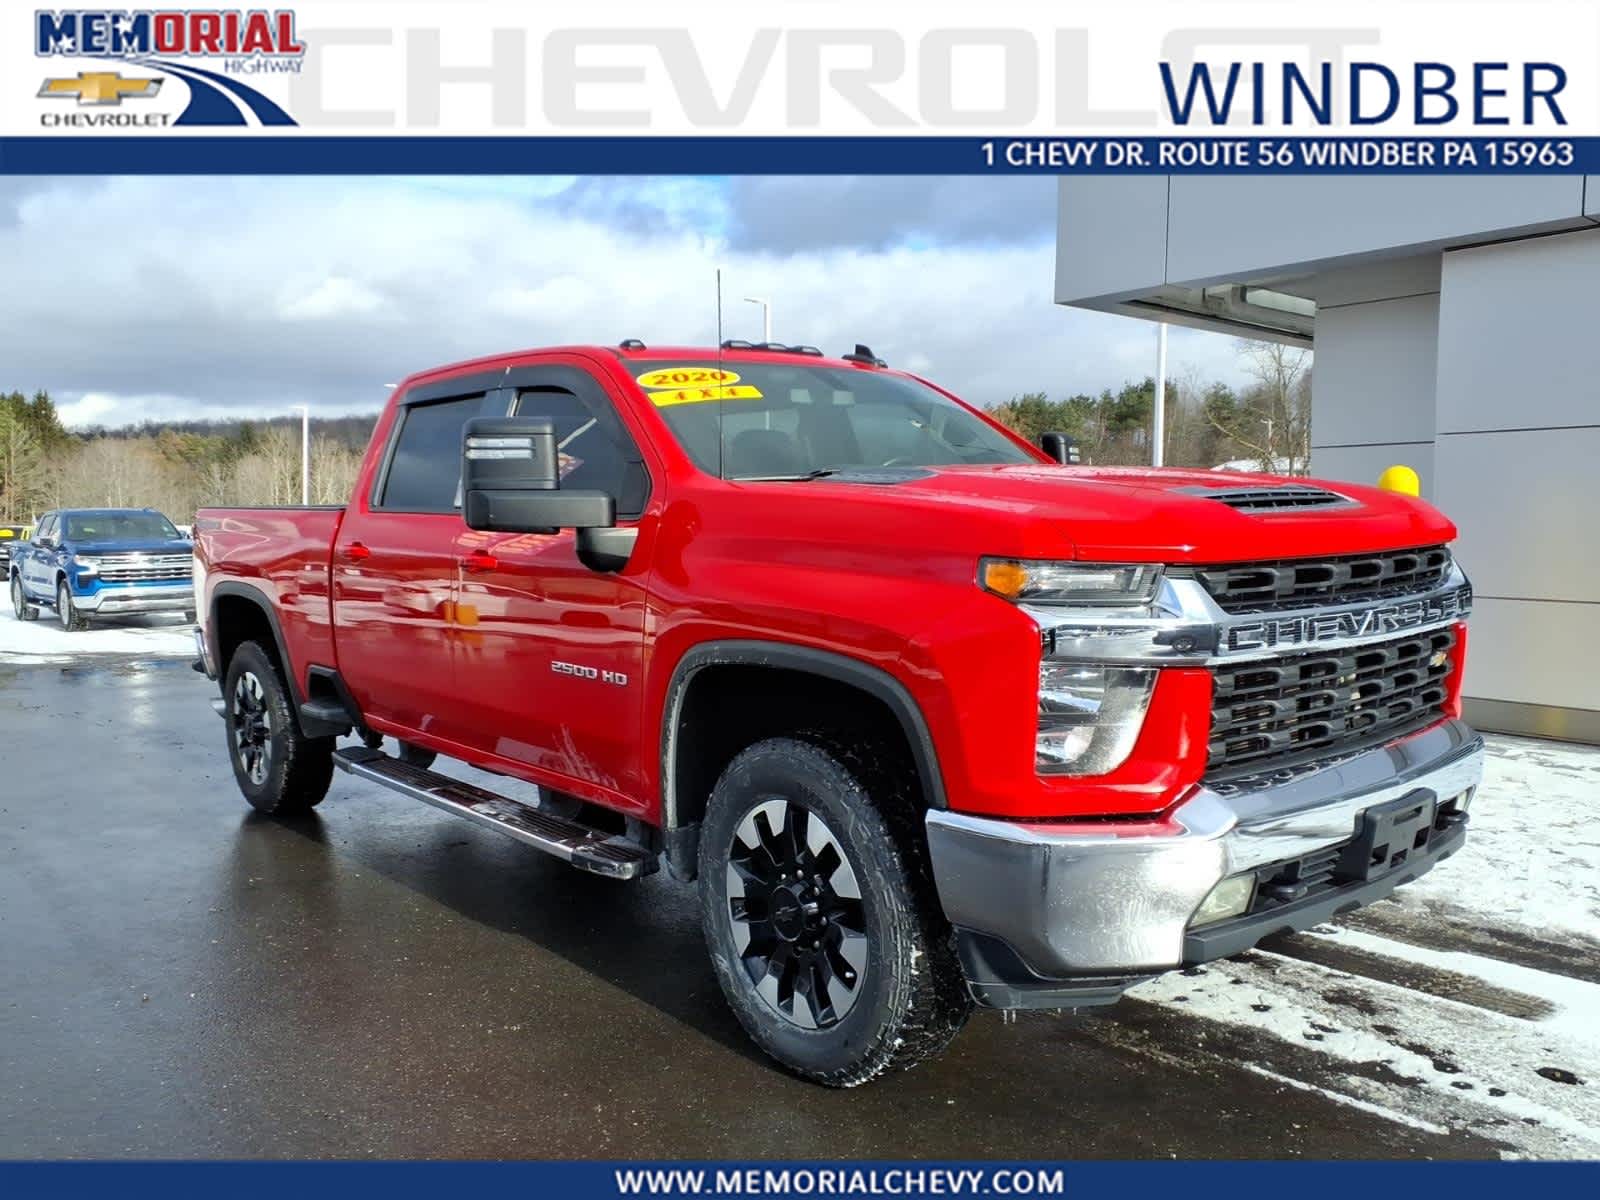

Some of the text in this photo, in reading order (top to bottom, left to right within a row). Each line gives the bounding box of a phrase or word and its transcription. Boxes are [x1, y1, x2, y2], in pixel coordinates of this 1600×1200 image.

[652, 371, 728, 386] 2020
[1227, 588, 1472, 652] CHEVROLET
[551, 660, 628, 686] 2500 HD
